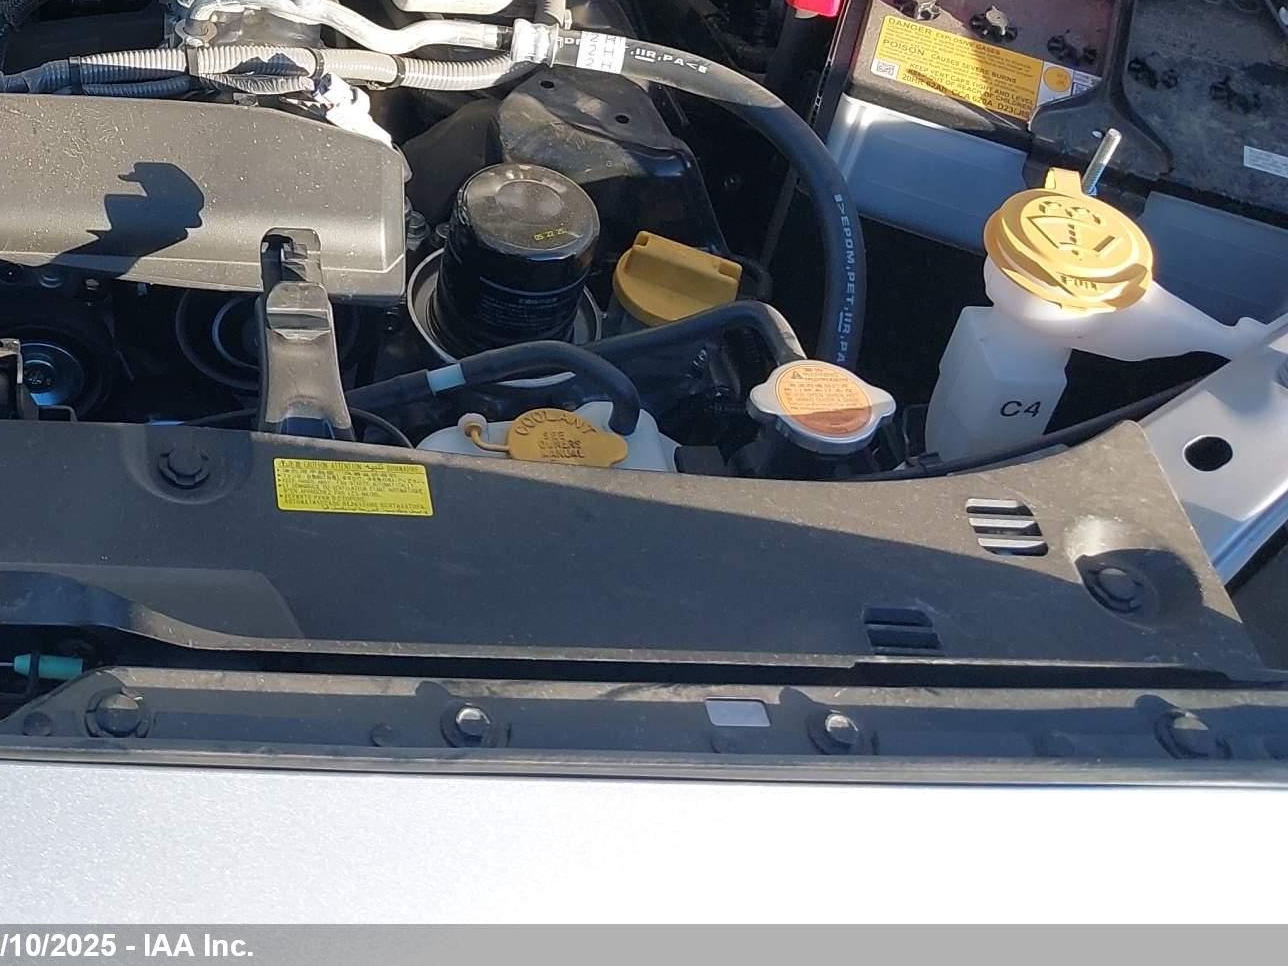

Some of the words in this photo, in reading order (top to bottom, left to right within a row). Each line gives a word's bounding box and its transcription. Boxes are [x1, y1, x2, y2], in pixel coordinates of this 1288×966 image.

[887, 17, 932, 35] DANGER
[882, 39, 925, 55] POISON
[990, 72, 1017, 82] BURNS
[1000, 400, 1041, 418] C4
[515, 411, 596, 436] COOLANT
